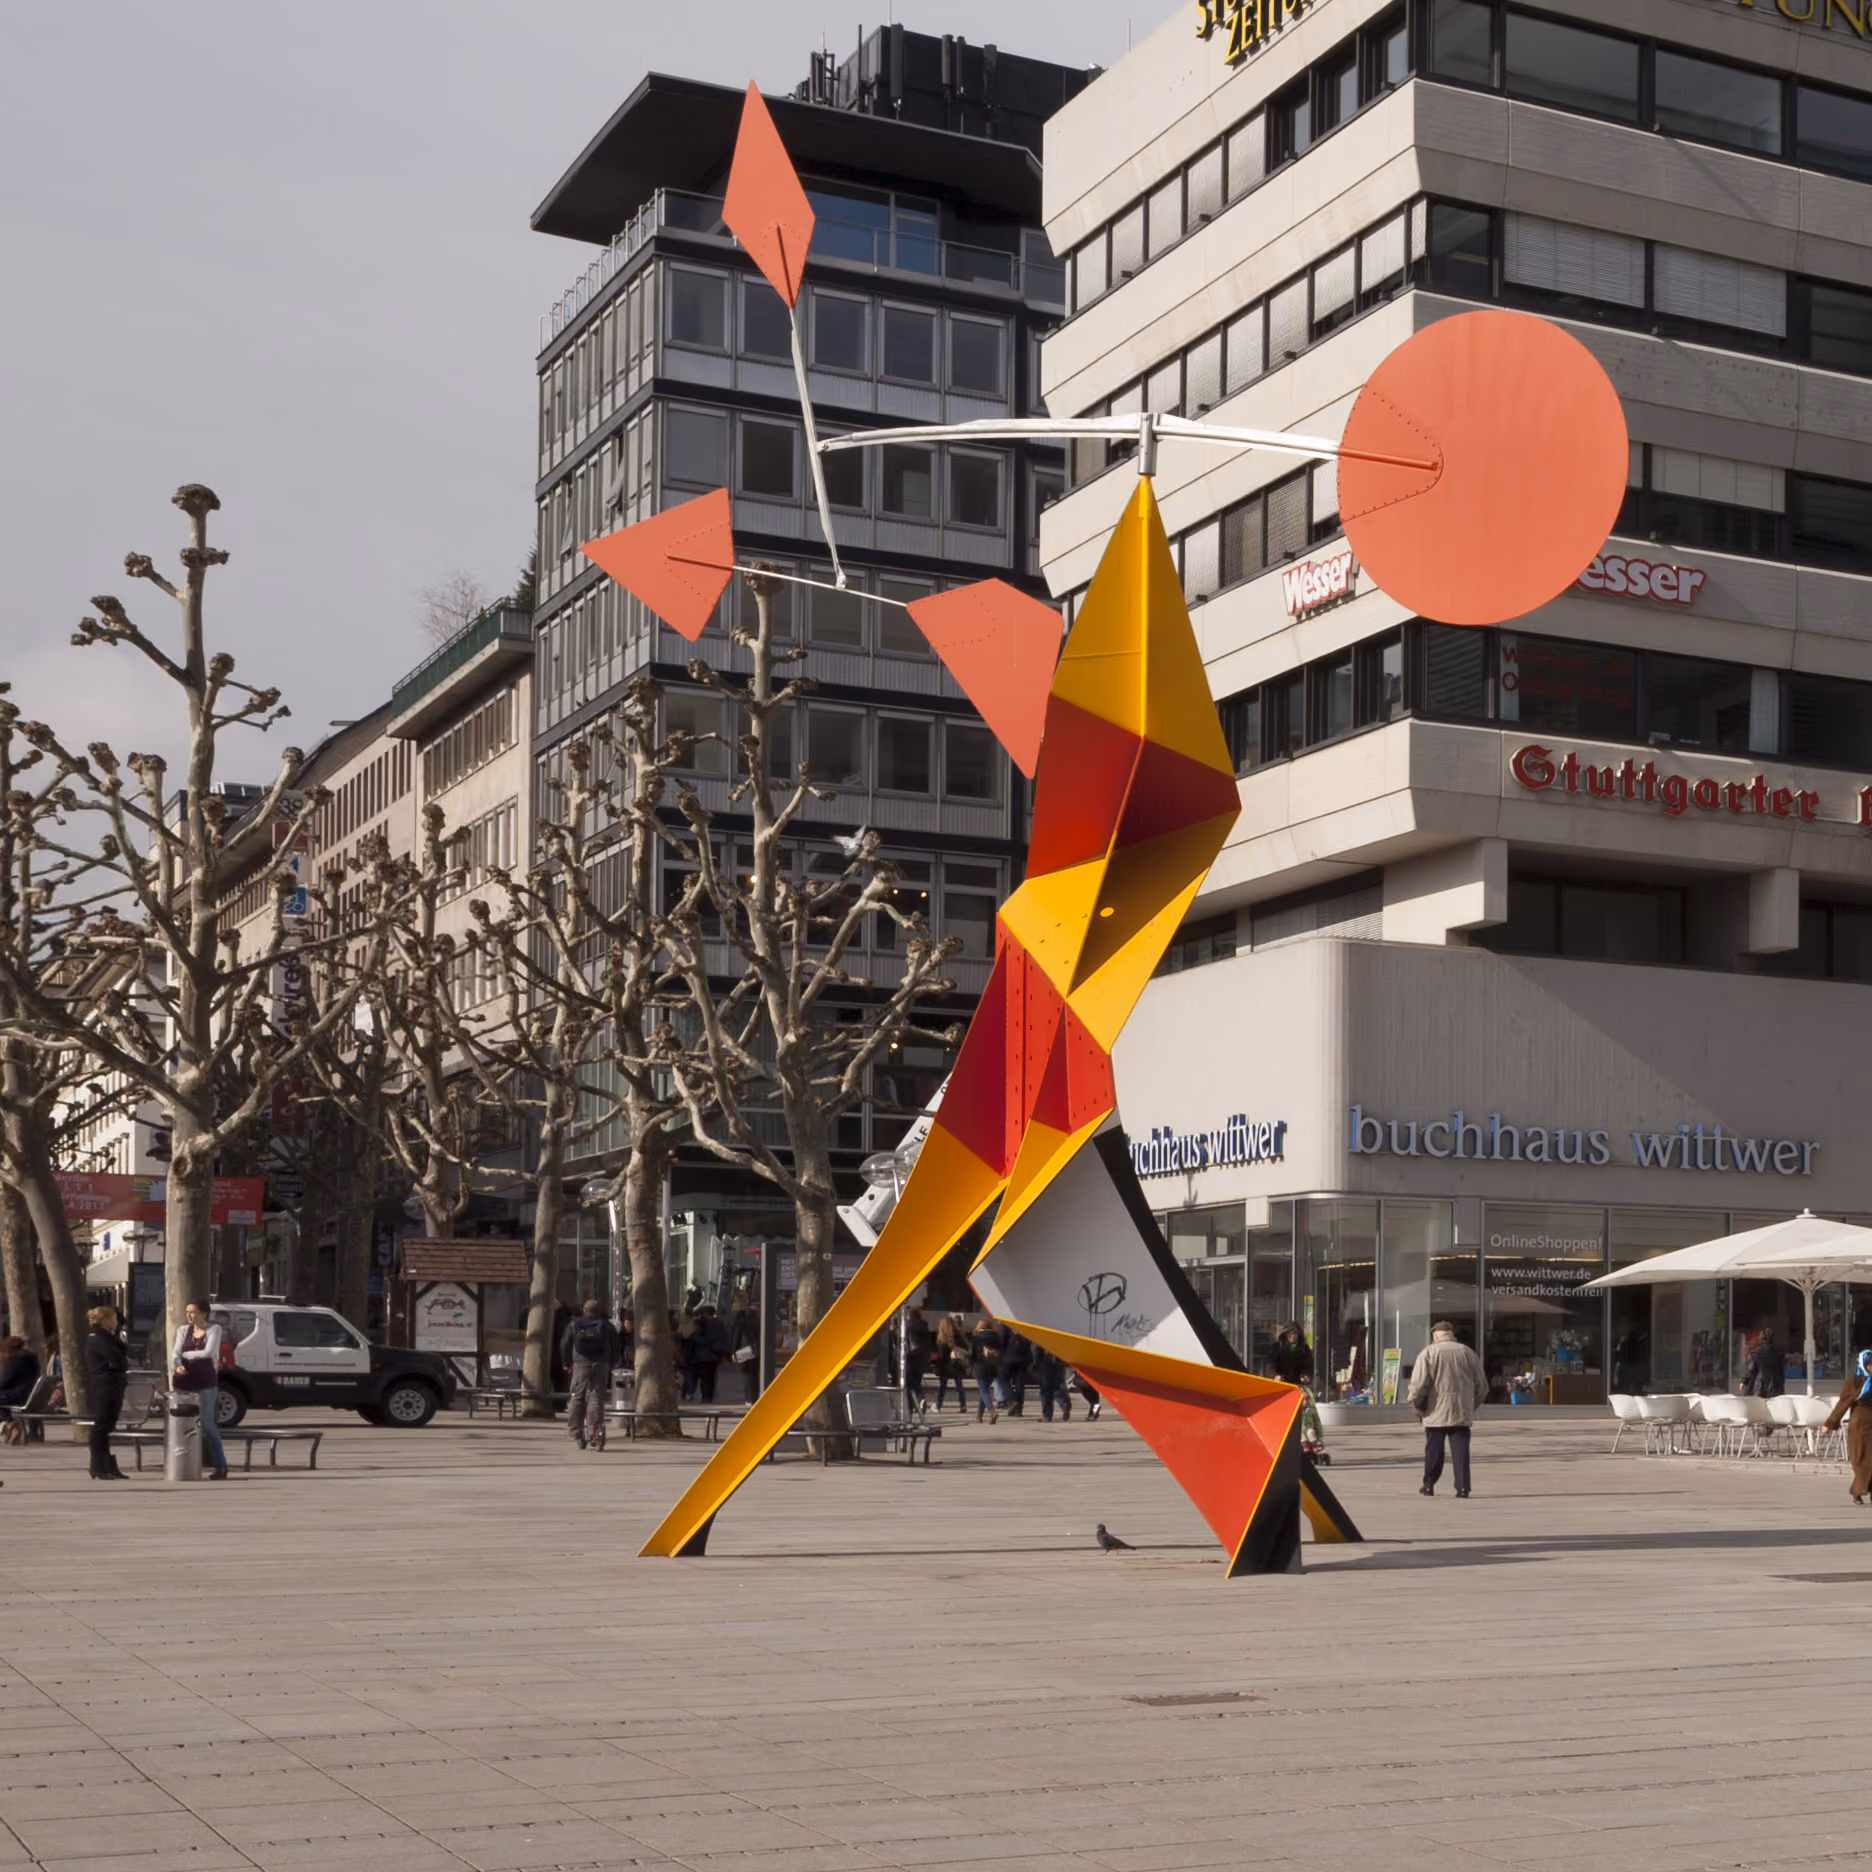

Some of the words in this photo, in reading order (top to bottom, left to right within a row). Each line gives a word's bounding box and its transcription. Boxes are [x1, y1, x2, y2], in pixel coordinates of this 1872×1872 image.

[1282, 551, 1354, 616] Wesser
[1578, 555, 1708, 606] esser
[1509, 744, 1820, 818] Stuttgarter
[1128, 1126, 1207, 1174] uchhaus
[1206, 1113, 1287, 1164] wittwer
[1348, 1104, 1610, 1166] buchhaus
[1630, 1124, 1821, 1176] wittwer
[1490, 1233, 1602, 1254] OnlineShoppen!
[1491, 1267, 1592, 1281] www.wittwer.de
